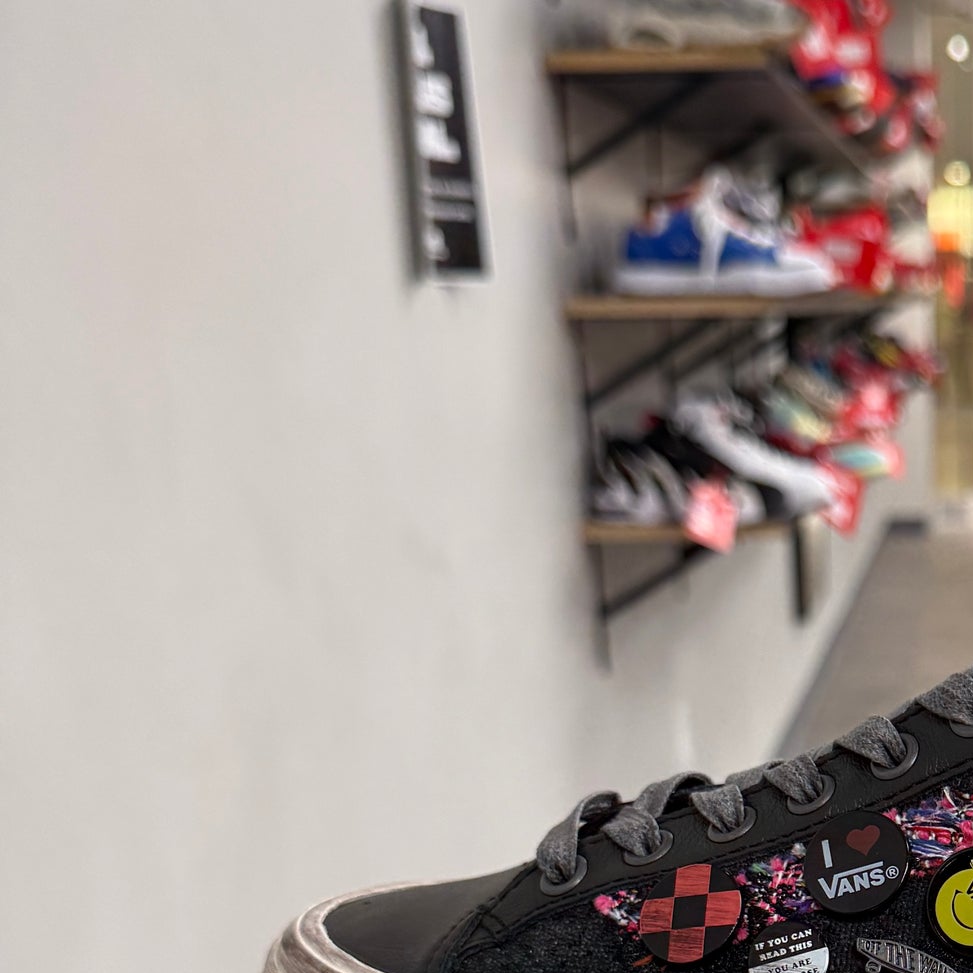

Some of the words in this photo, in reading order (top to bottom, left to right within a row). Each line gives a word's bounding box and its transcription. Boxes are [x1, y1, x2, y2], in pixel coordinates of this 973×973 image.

[821, 839, 833, 868] I
[754, 942, 765, 951] IF
[767, 935, 789, 947] YOU
[791, 928, 812, 940] CAN
[759, 948, 787, 961] READ
[788, 940, 813, 953] THIS
[792, 958, 812, 969] ARE
[884, 942, 915, 970] THE
